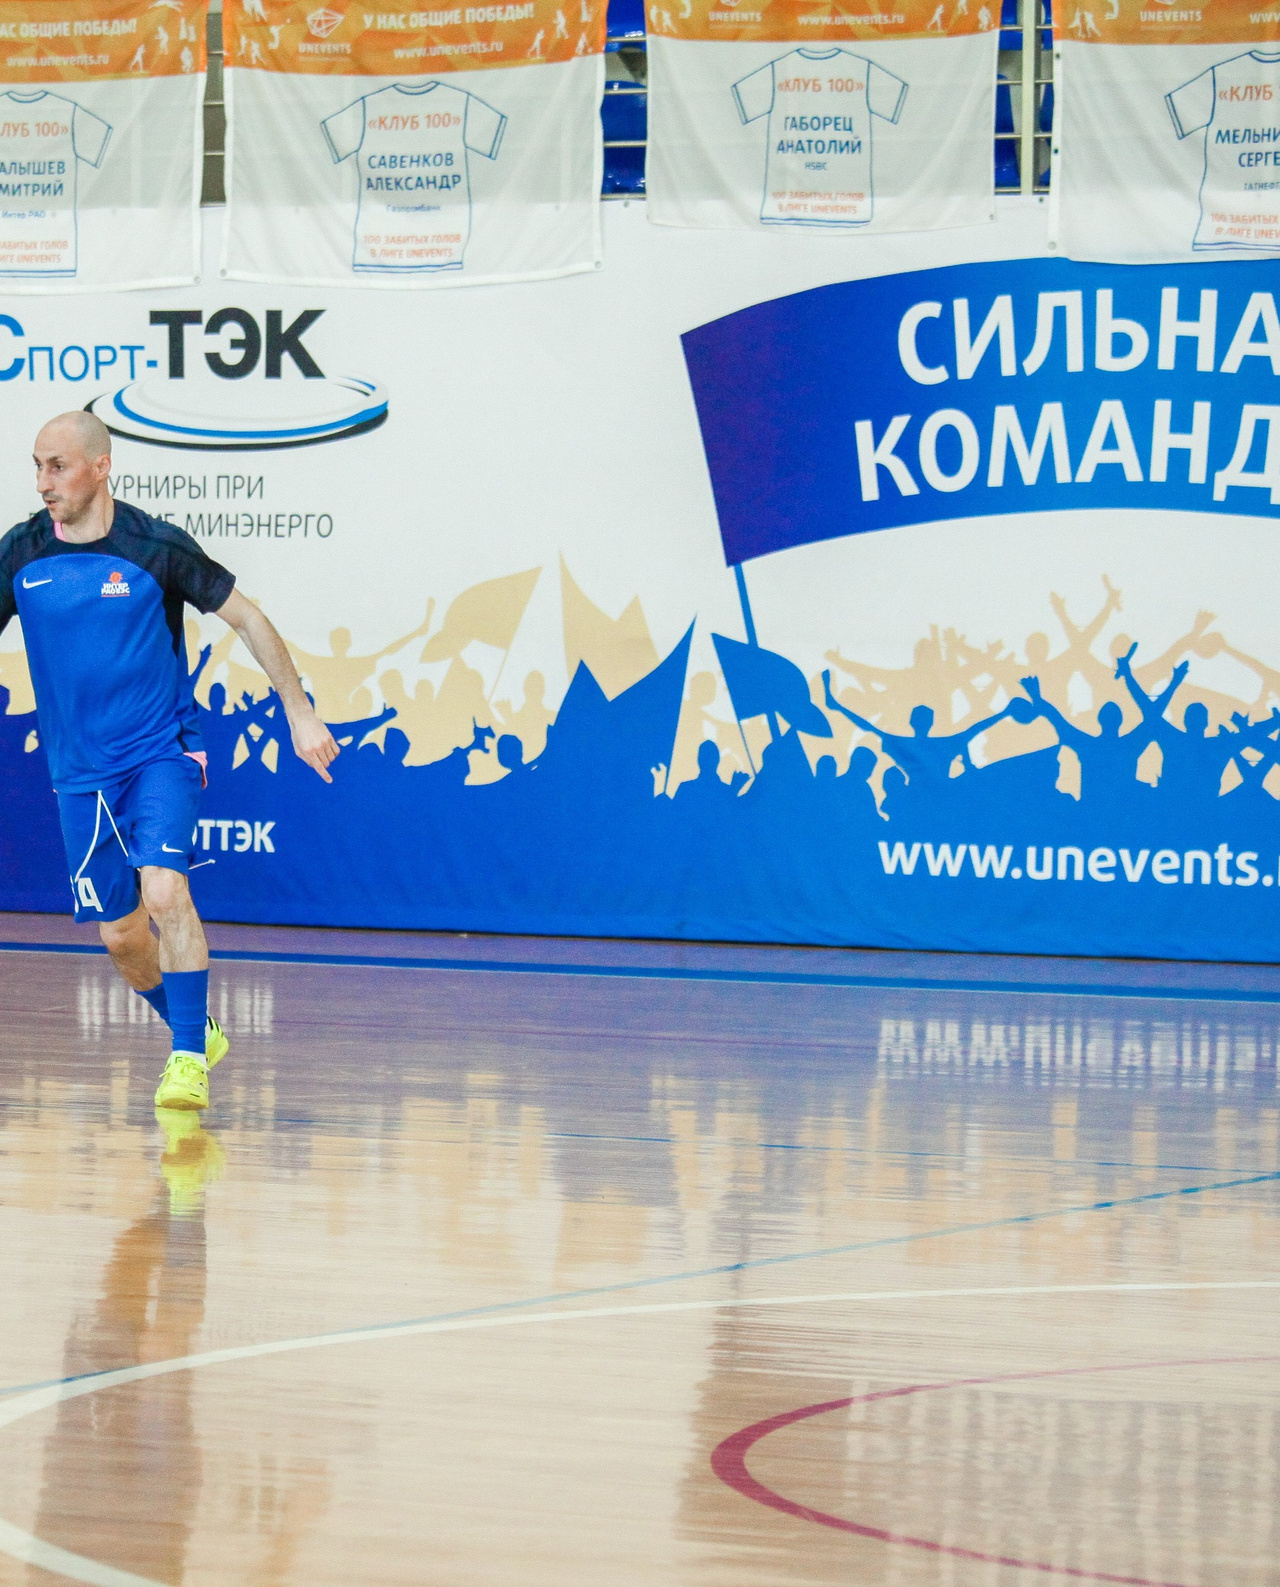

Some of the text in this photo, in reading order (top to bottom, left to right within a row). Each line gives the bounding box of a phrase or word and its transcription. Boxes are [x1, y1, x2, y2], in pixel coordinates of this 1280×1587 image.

[363, 3, 534, 30] У НАС ОБЩИЕ ПОБЕДЫ!
[708, 11, 762, 23] UNEVENTS
[798, 14, 905, 26] www.unevents.ru
[1140, 10, 1202, 22] UNEVENTS
[20, 22, 70, 38] ОБЩИЕ
[74, 18, 137, 36] ПОБЕДЫ!
[298, 42, 351, 55] UNEVENTS
[393, 41, 504, 60] www.unevents.ru
[6, 54, 110, 68] www.unevents.ru
[778, 78, 864, 93] «КЛУБ 100»
[1219, 84, 1274, 102] «КЛУБ
[35, 122, 69, 138] 100»
[367, 113, 462, 131] «КЛУБ 100»
[784, 116, 853, 132] ГАБОРЕЦ
[776, 135, 862, 155] АНАТОЛИЙ
[368, 152, 454, 169] САВЕНКОВ
[805, 162, 828, 170] HSBC
[366, 174, 462, 192] АЛЕКСАНДР
[897, 286, 1280, 386] СИЛЬНА
[108, 474, 264, 500] УРНИРЫ ПРИ
[185, 512, 334, 539] МИНЭНЕРГО
[191, 818, 277, 853] ТТЭК
[70, 875, 104, 913] 4
